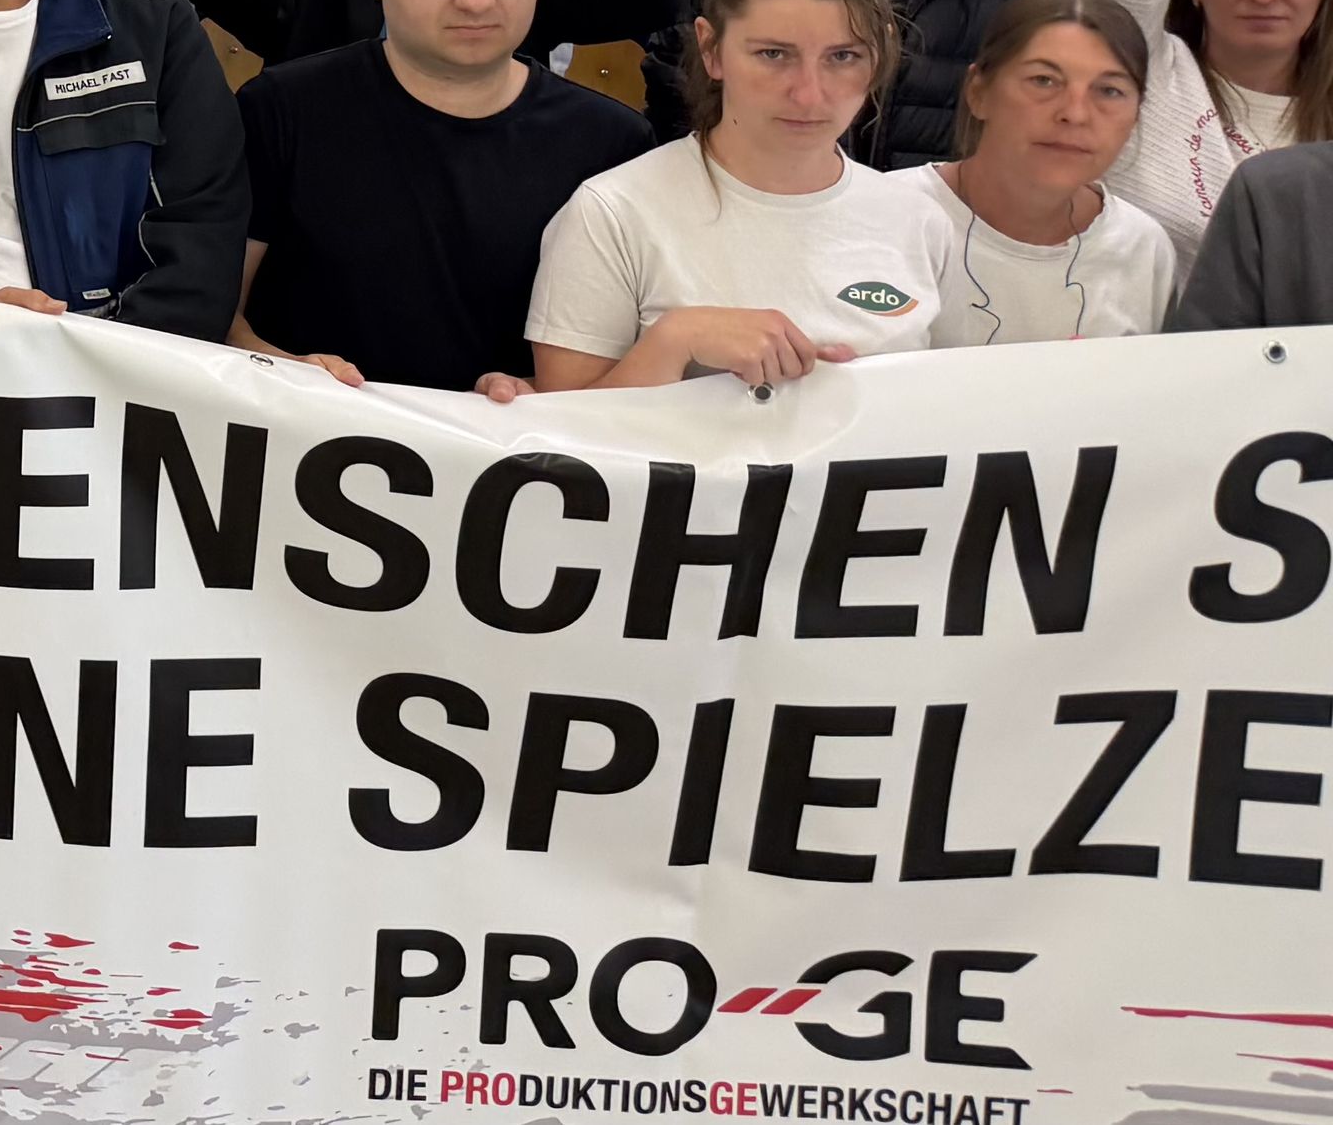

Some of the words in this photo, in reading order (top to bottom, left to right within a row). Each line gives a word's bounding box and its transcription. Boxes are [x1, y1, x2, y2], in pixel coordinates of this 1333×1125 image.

[56, 78, 100, 94] MICHAEL
[103, 69, 131, 85] FAST
[848, 285, 900, 306] ardo
[1188, 431, 1333, 624] S
[348, 672, 1333, 891] SPIELZE
[367, 1068, 428, 1102] DIE
[440, 1070, 1030, 1125] PRODUKTIONSGEWERKSCHAFT
